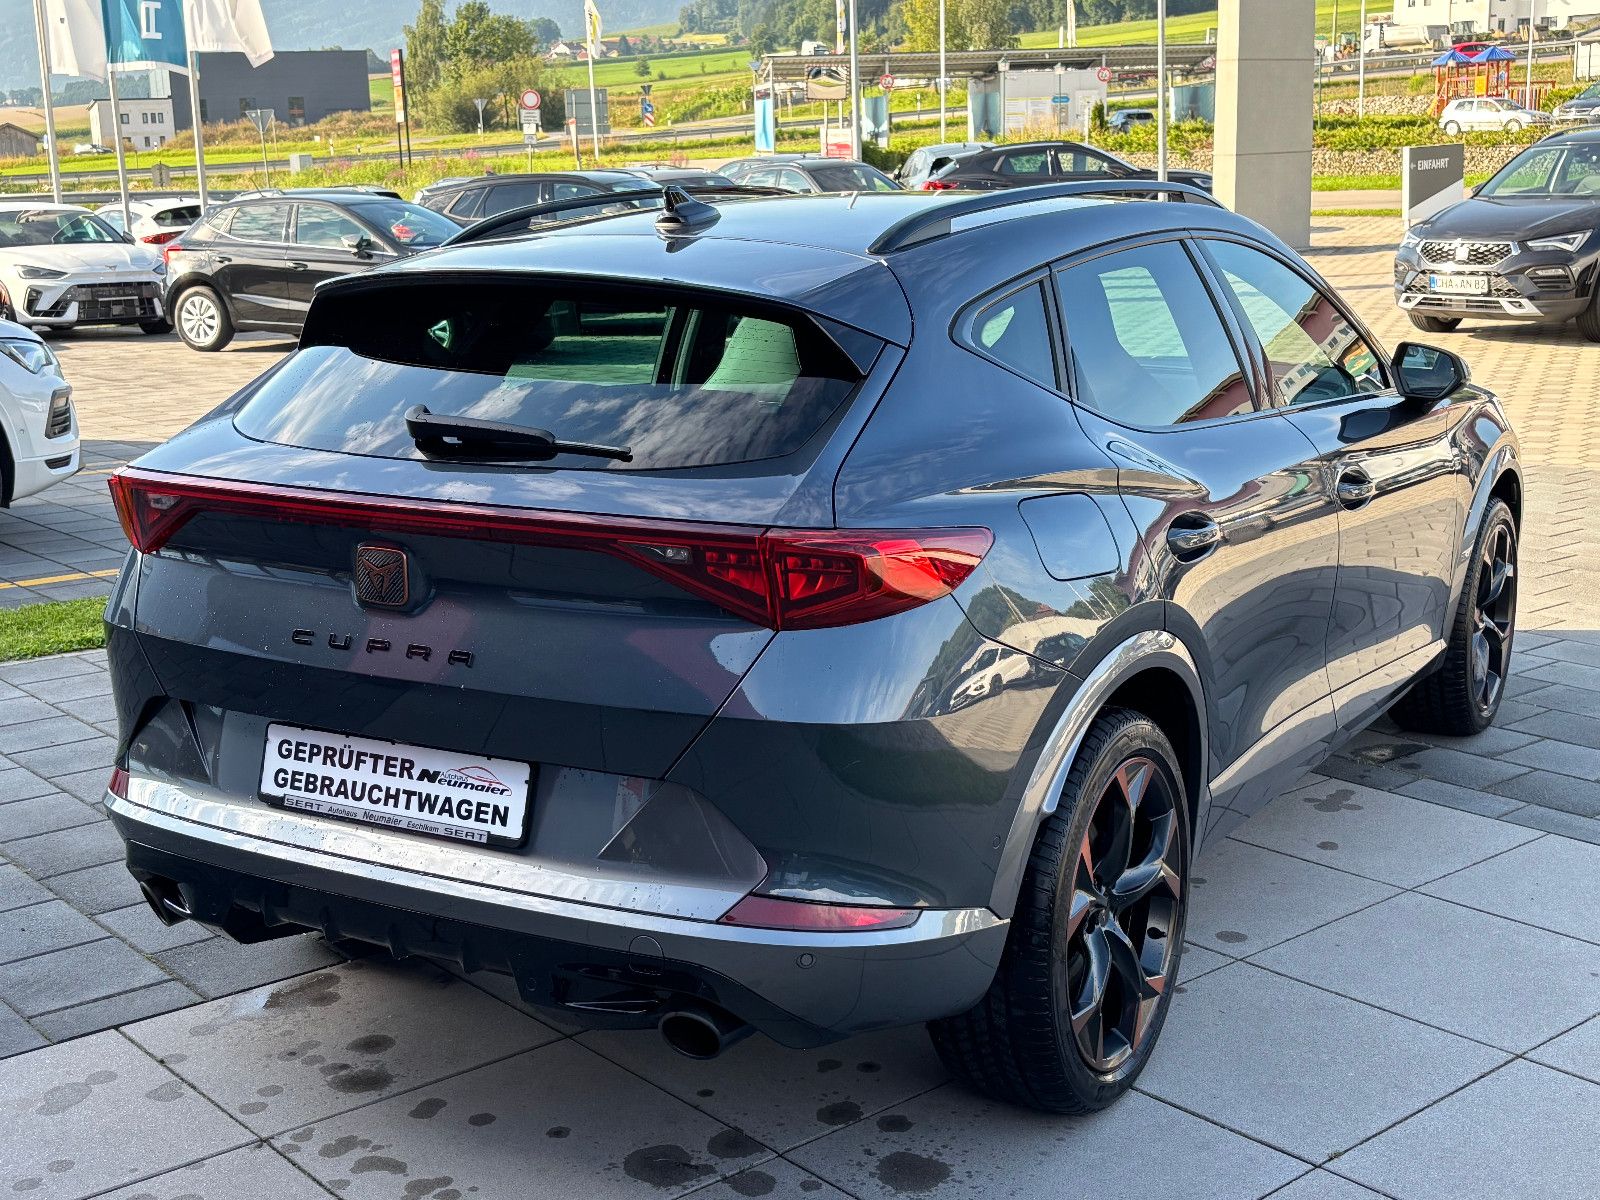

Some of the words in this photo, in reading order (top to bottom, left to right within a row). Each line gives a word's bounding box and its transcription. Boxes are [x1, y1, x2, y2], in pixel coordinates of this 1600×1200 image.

[1417, 157, 1449, 171] EINFAHRT
[1435, 278, 1454, 289] CHA
[1460, 279, 1472, 289] AN
[291, 628, 475, 669] CUPRA
[277, 738, 415, 781] GEPRÜFTER
[273, 767, 510, 828] GEBRAUCHTWAGEN
[416, 768, 510, 797] Neumaier
[285, 797, 324, 811] SEAT
[327, 805, 358, 818] Autohaus
[362, 810, 403, 826] Neumaier
[444, 827, 487, 841] SEAT
